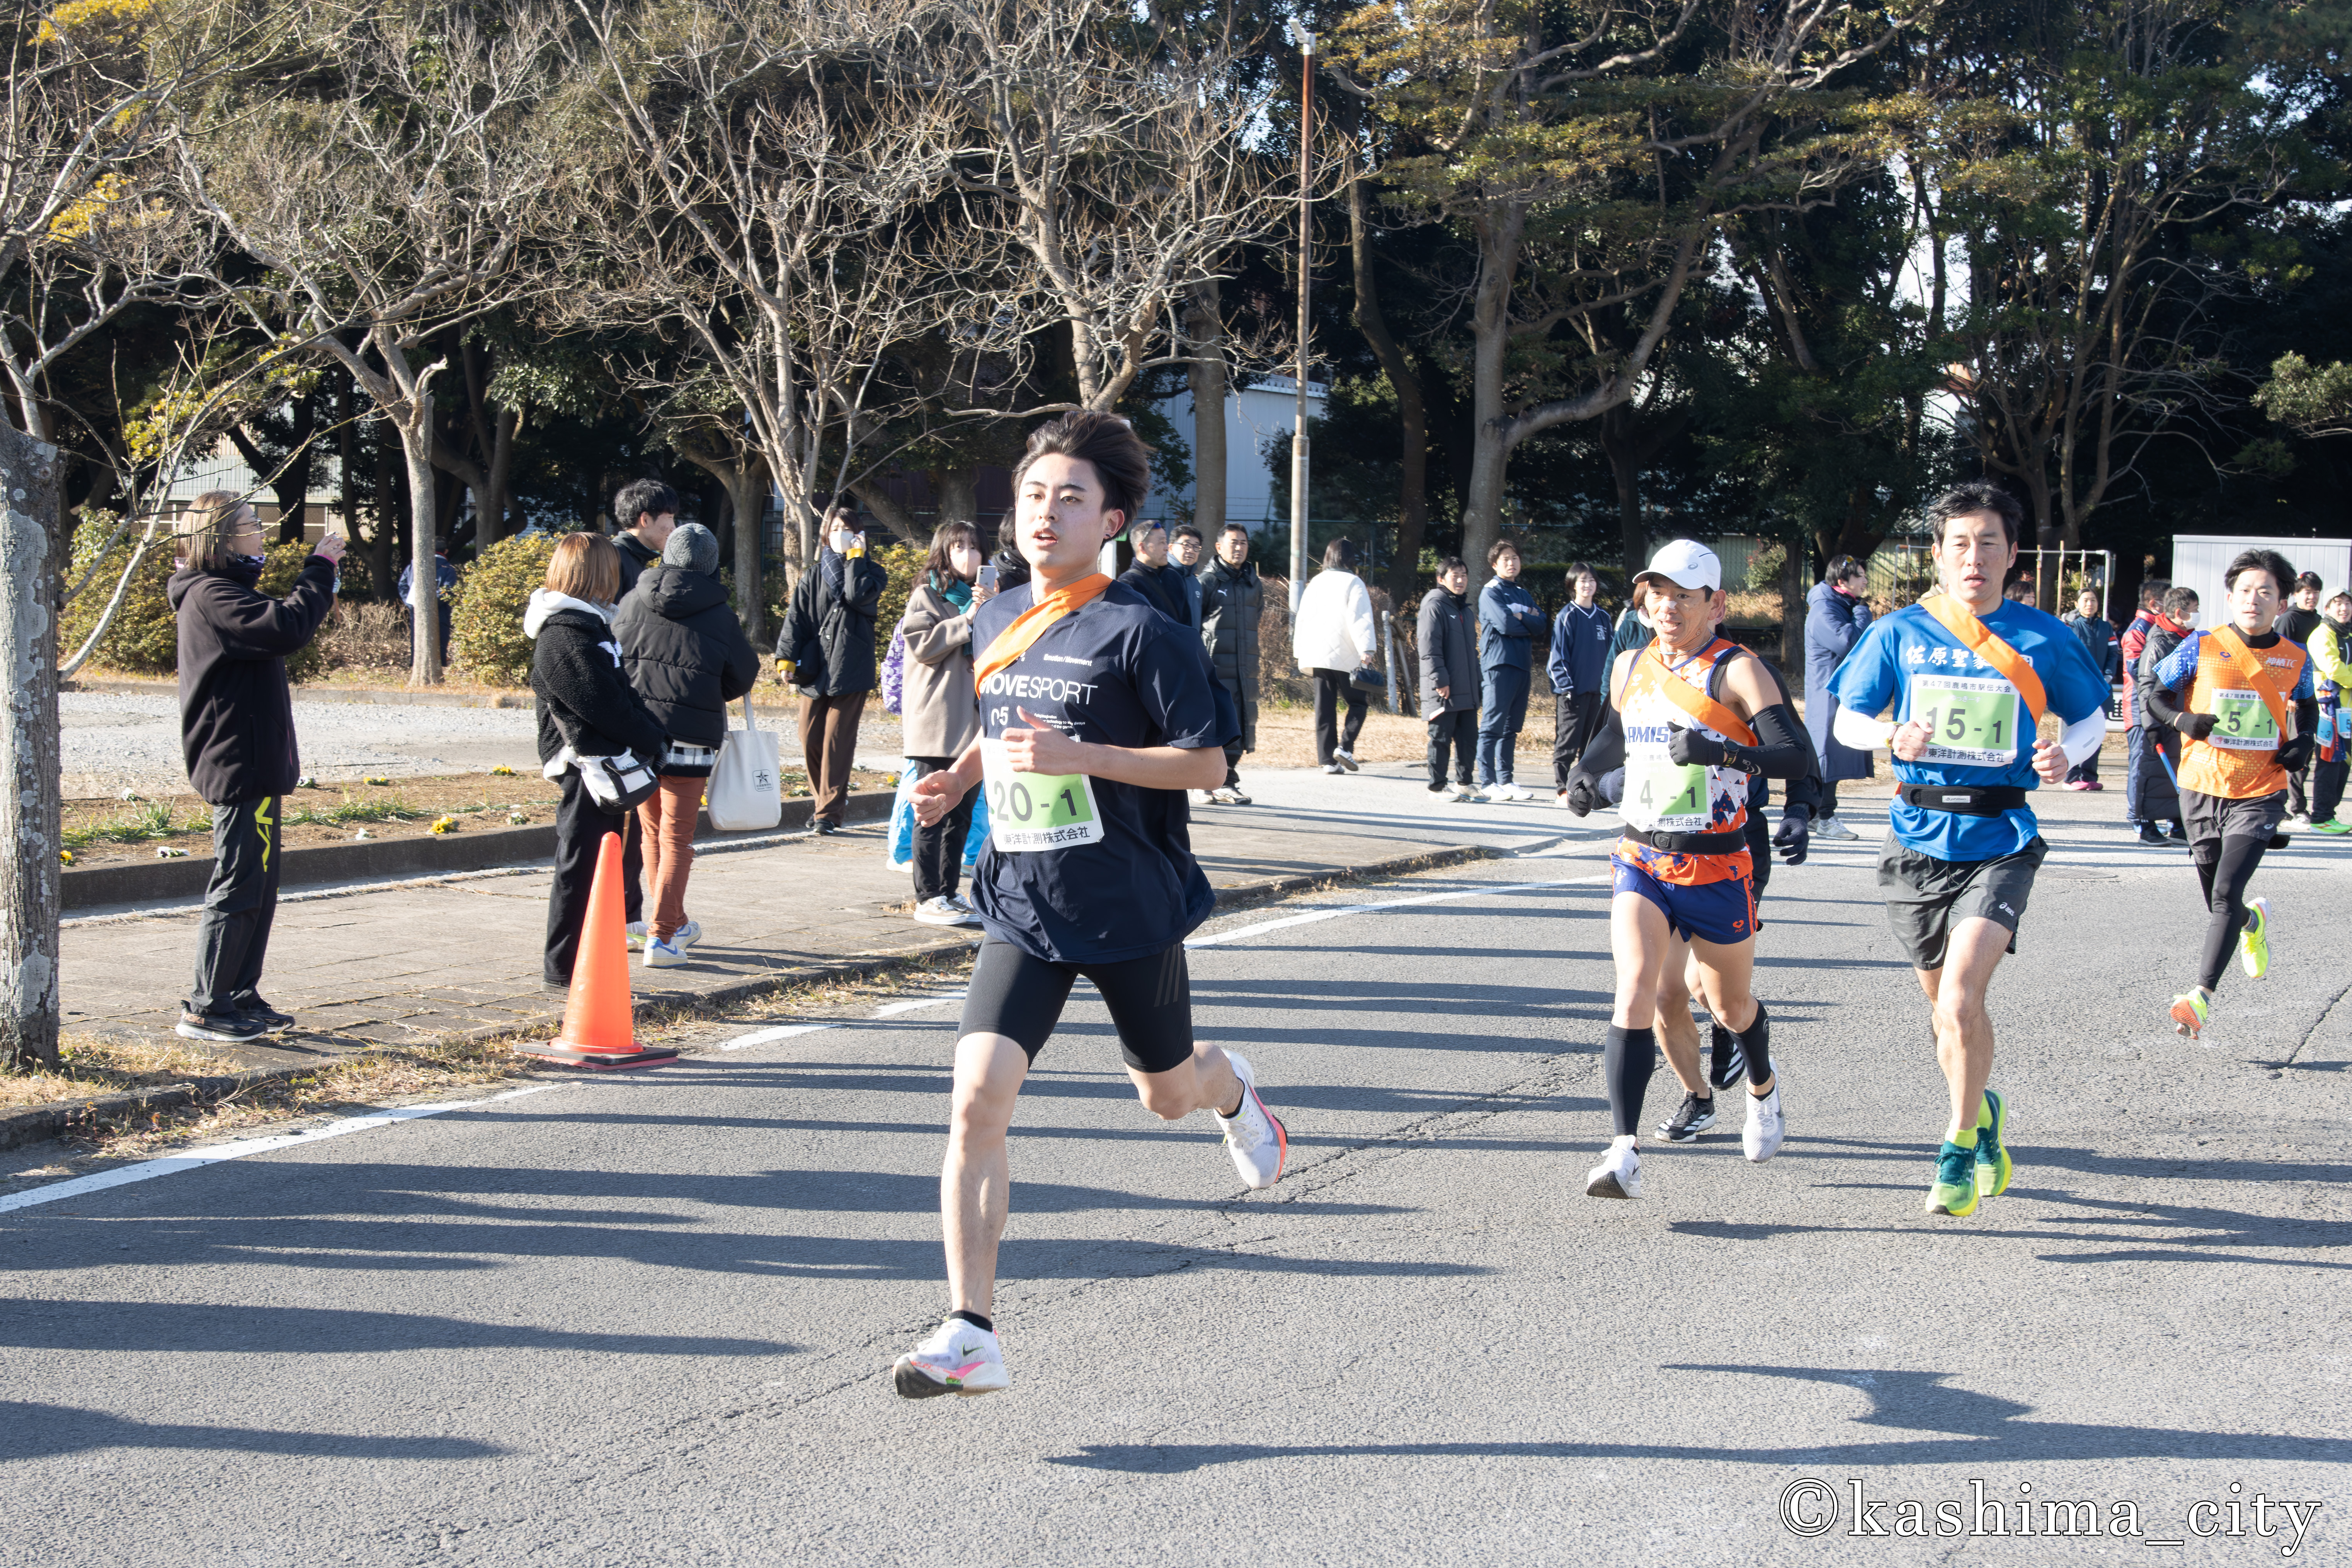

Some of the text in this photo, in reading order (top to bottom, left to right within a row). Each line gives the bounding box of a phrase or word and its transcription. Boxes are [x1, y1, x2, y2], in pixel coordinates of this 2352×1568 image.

[980, 673, 1098, 705] MOVESPORT
[1922, 680, 2011, 693] 第47回鹿嶋市駅伝大会
[1926, 707, 2002, 743] 15-1
[2228, 711, 2272, 734] 5-1
[1624, 727, 1671, 743] AMIS
[1928, 748, 2005, 763] 東洋計測株式会社
[994, 780, 1077, 822] 20-1
[1640, 780, 1695, 809] 4-1
[1634, 817, 1702, 827] 東洋計測株式会社
[1003, 826, 1090, 845] 東洋計測株式会社
[182, 1011, 205, 1025] HOKA
